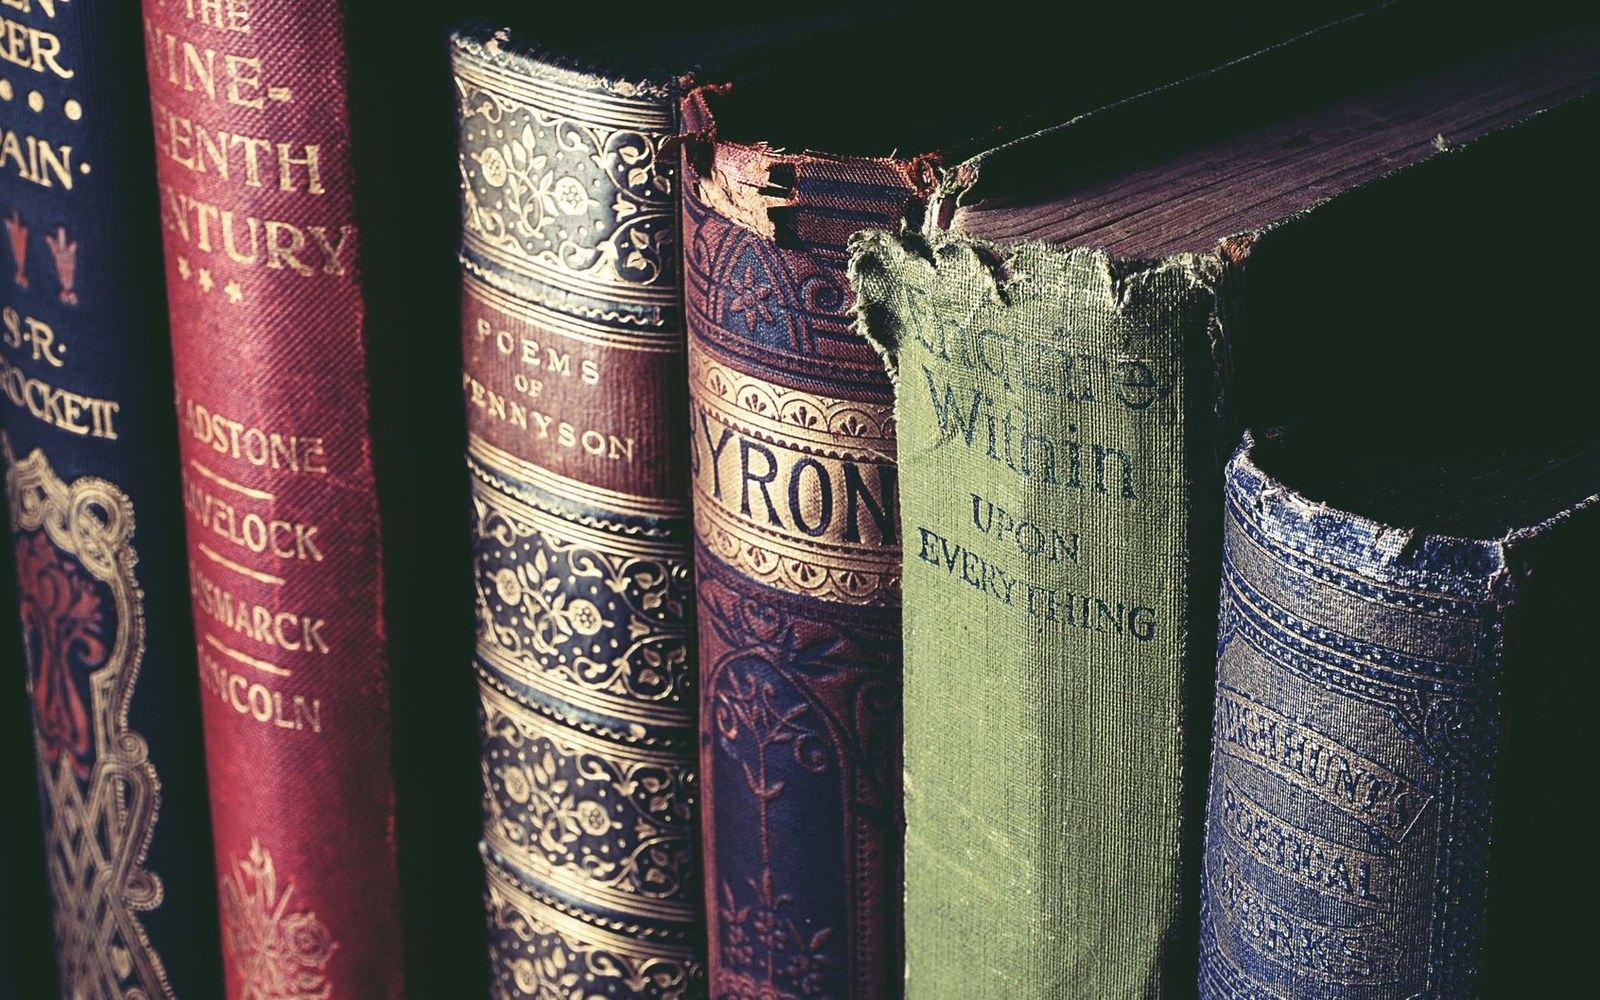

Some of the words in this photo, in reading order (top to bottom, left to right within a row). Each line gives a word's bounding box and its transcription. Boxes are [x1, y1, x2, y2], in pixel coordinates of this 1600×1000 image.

[0, 128, 92, 191] AIN.
[476, 317, 599, 385] POEMS
[514, 372, 544, 398] OF
[920, 363, 1140, 501] Within
[969, 493, 1081, 565] UPON
